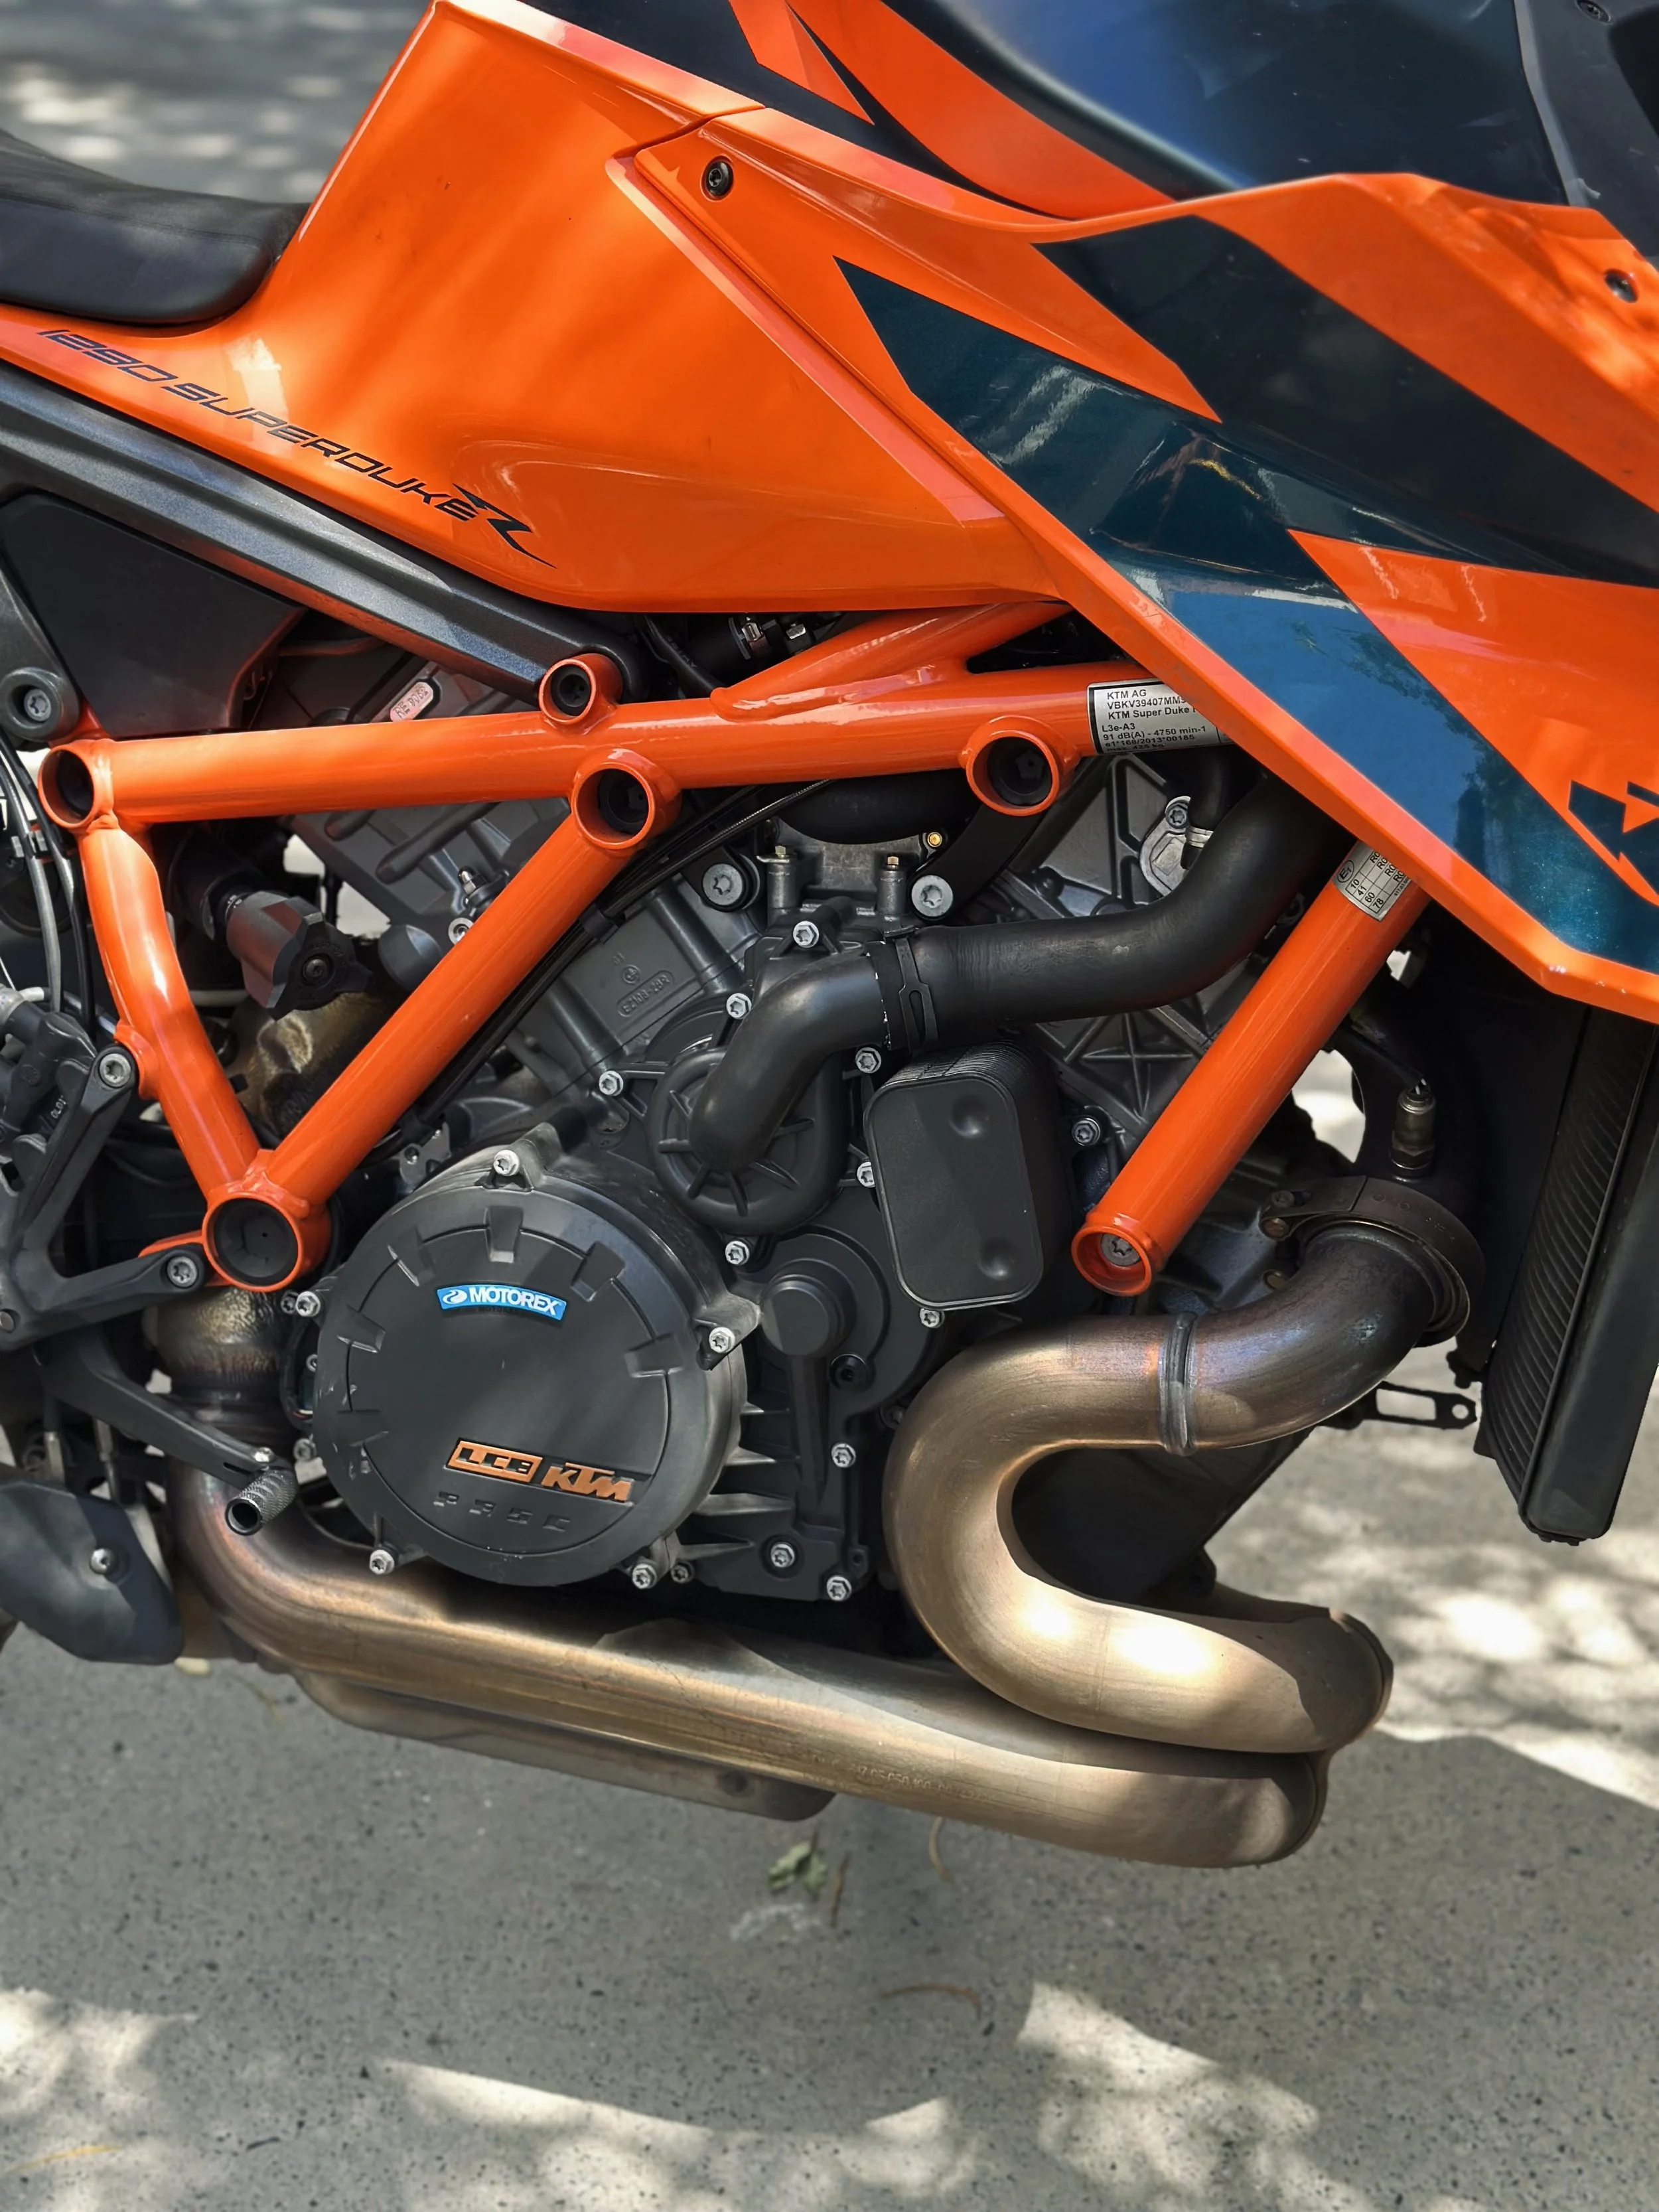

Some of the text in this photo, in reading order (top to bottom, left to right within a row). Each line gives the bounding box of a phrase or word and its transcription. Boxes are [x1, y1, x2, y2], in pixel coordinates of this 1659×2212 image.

[37, 329, 179, 382] 1290
[1107, 689, 1147, 700] KTM AG
[1108, 711, 1129, 719] KTM
[1133, 709, 1161, 718] Super
[1102, 722, 1135, 732] L3e-A3
[1118, 731, 1145, 739] dB(A)
[1179, 725, 1206, 734] min-1
[1350, 879, 1360, 889] 10
[1358, 885, 1367, 896] 41
[1364, 892, 1375, 903] 60
[1372, 898, 1384, 909] 78
[469, 1286, 559, 1316] MOTOREX
[541, 1462, 633, 1502] KTM
